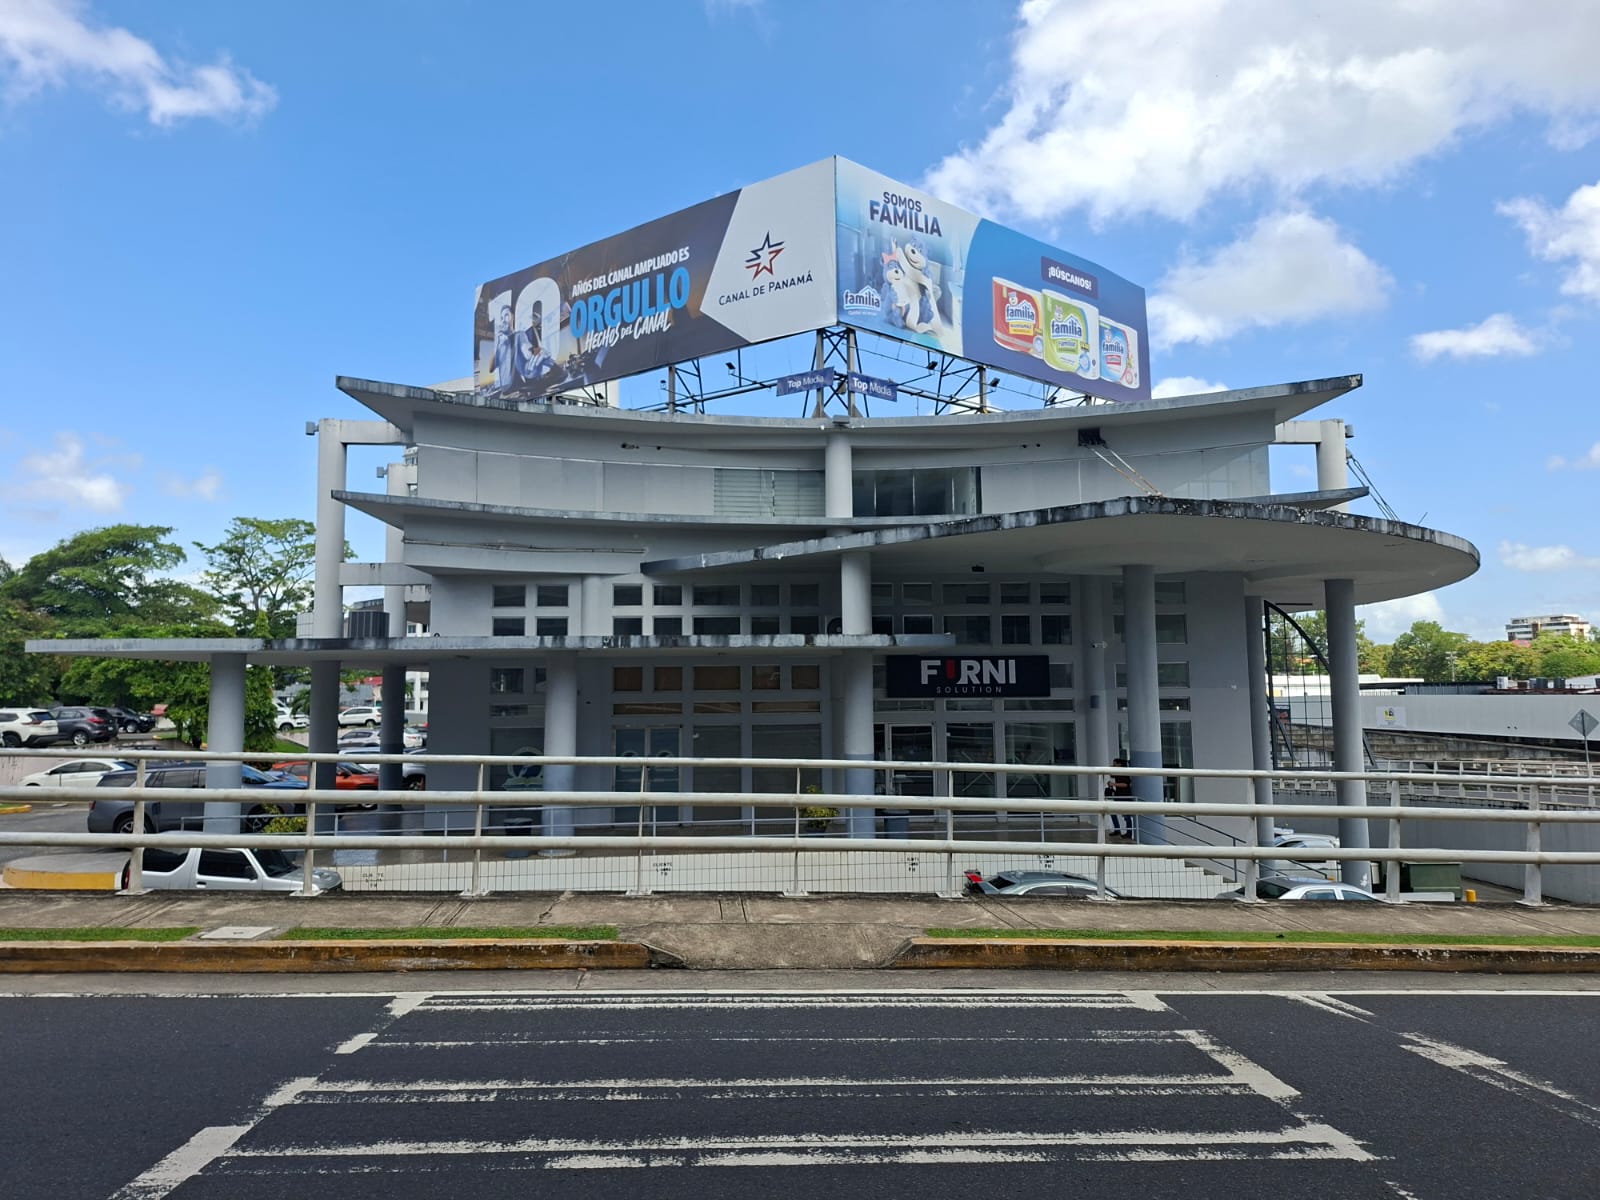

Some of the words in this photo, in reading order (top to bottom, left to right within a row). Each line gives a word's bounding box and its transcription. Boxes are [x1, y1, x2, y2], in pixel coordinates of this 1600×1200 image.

[883, 191, 922, 212] SOMOS
[869, 199, 942, 237] FAMILIA
[572, 279, 593, 298] AÑOS
[593, 274, 608, 291] DEL
[608, 265, 634, 285] CANAL
[634, 250, 678, 277] AMPLIADO
[678, 246, 690, 262] ES
[718, 290, 750, 306] CANAL
[752, 285, 765, 297] DE
[768, 269, 813, 292] PANAMÁ
[570, 266, 690, 339] ORGULLO
[845, 290, 880, 308] familia
[1006, 304, 1035, 321] familia
[488, 277, 561, 387] 10
[583, 322, 621, 353] HECHOS
[621, 324, 633, 340] DEL
[633, 307, 671, 340] CANAL
[1051, 319, 1082, 337] familia
[787, 380, 802, 389] Top
[852, 377, 868, 392] Top
[869, 383, 892, 396] Media
[936, 686, 1003, 694] SOLUTION
